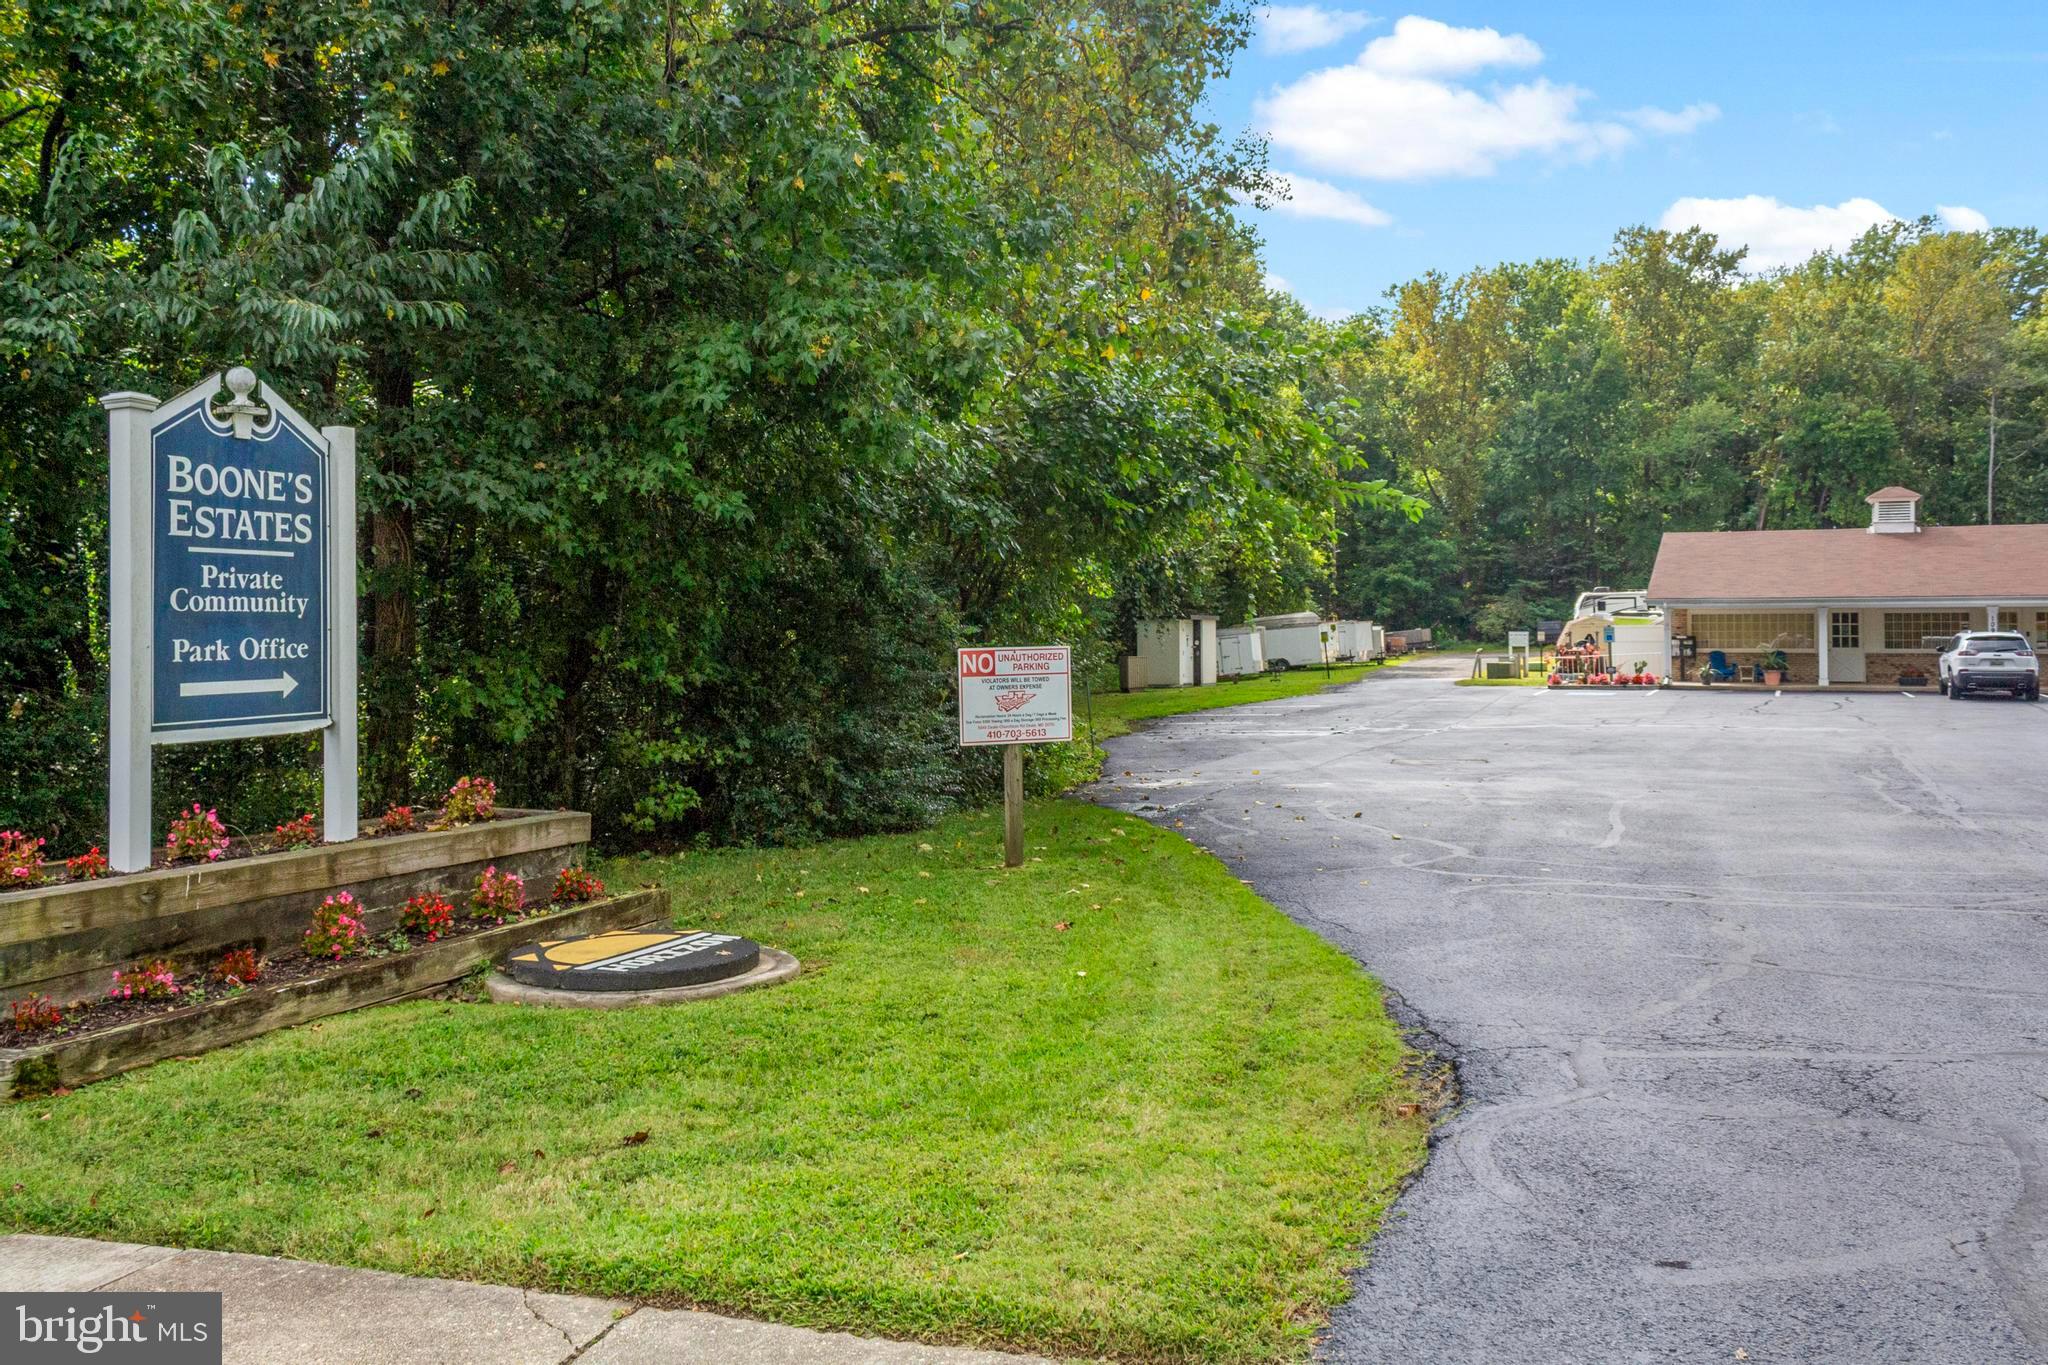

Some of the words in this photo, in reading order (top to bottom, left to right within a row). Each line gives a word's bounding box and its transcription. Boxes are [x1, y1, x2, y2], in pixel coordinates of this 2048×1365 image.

[168, 499, 313, 544] ESTATES
[200, 564, 284, 590] Private
[170, 588, 309, 619] Community
[172, 639, 231, 663] Park
[239, 637, 309, 661] Office
[998, 653, 1064, 662] UNAUTHORIZED
[962, 653, 994, 674] NO
[1012, 662, 1050, 671] PARKING
[987, 728, 1047, 739] 410-703-5613
